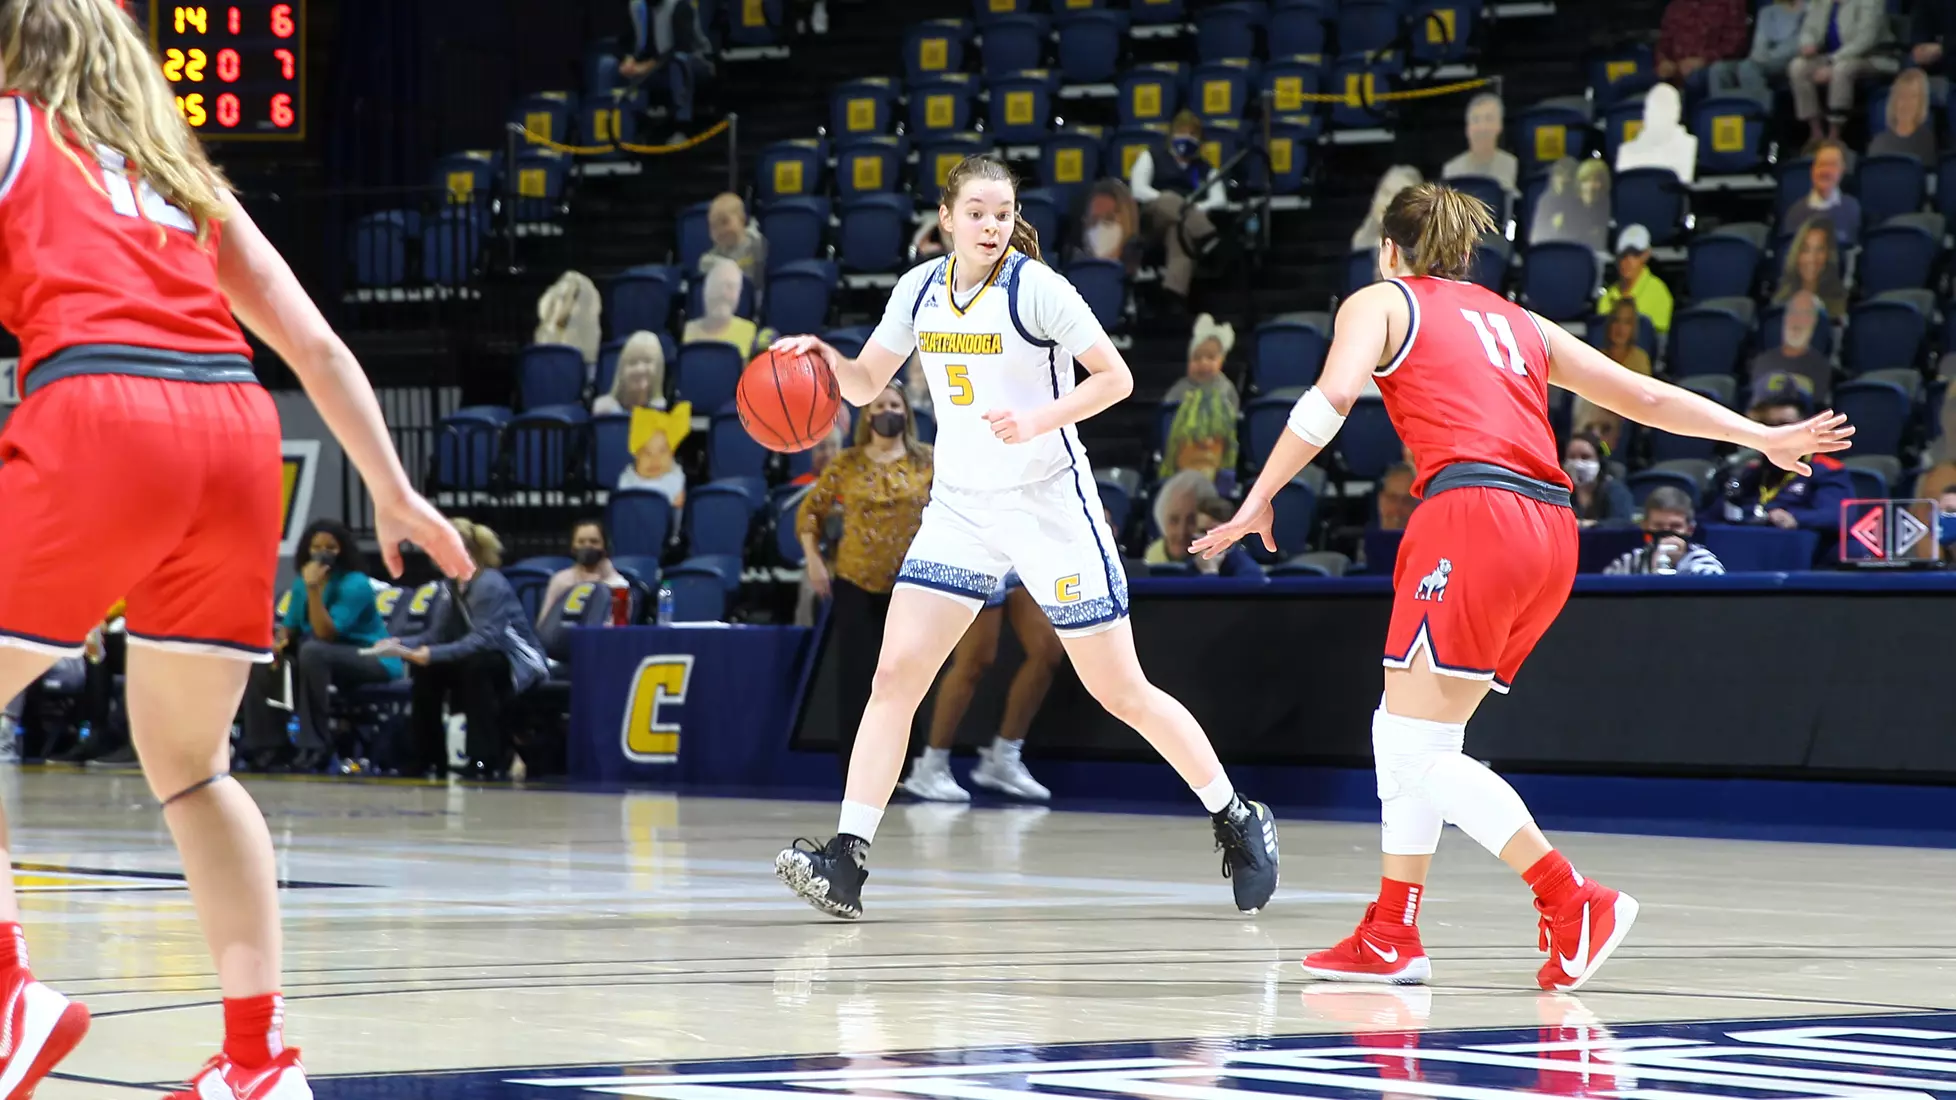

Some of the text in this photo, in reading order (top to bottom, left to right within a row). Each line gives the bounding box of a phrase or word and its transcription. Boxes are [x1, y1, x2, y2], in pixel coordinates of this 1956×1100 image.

[174, 3, 295, 38] 14 1 6
[163, 48, 295, 82] 22 0 7
[216, 92, 241, 128] 0
[270, 92, 295, 128] 6
[918, 330, 1003, 355] CHATTANOOGA
[1459, 308, 1528, 377] 11
[945, 364, 974, 405] 5
[1055, 573, 1081, 604] C
[621, 654, 695, 763] C
